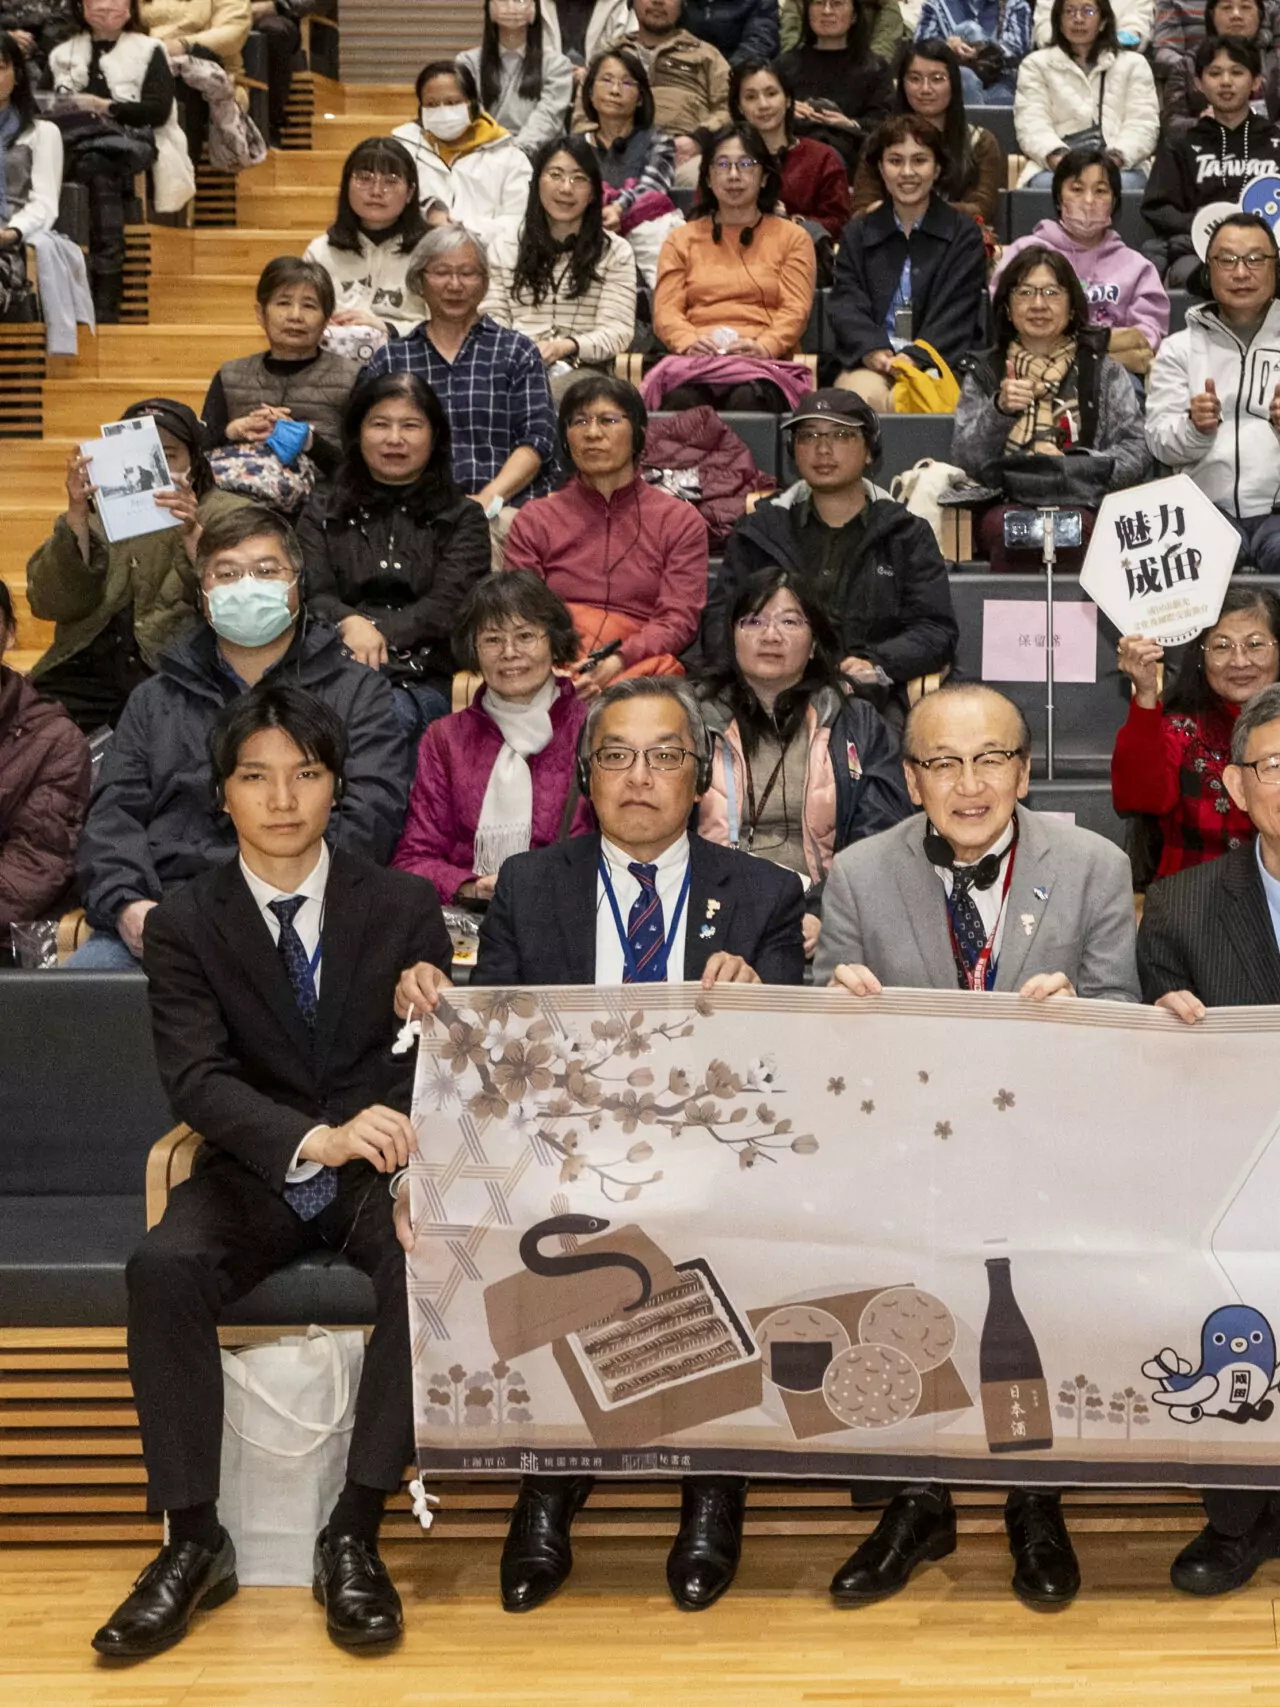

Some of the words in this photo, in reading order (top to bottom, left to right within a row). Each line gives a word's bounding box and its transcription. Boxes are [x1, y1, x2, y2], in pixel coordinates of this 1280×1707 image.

[1195, 154, 1279, 184] Taiwan
[1114, 504, 1186, 553] 魅力
[1125, 543, 1202, 601] 成田
[1234, 1373, 1247, 1398] 成田
[1010, 1384, 1026, 1437] 日本酒
